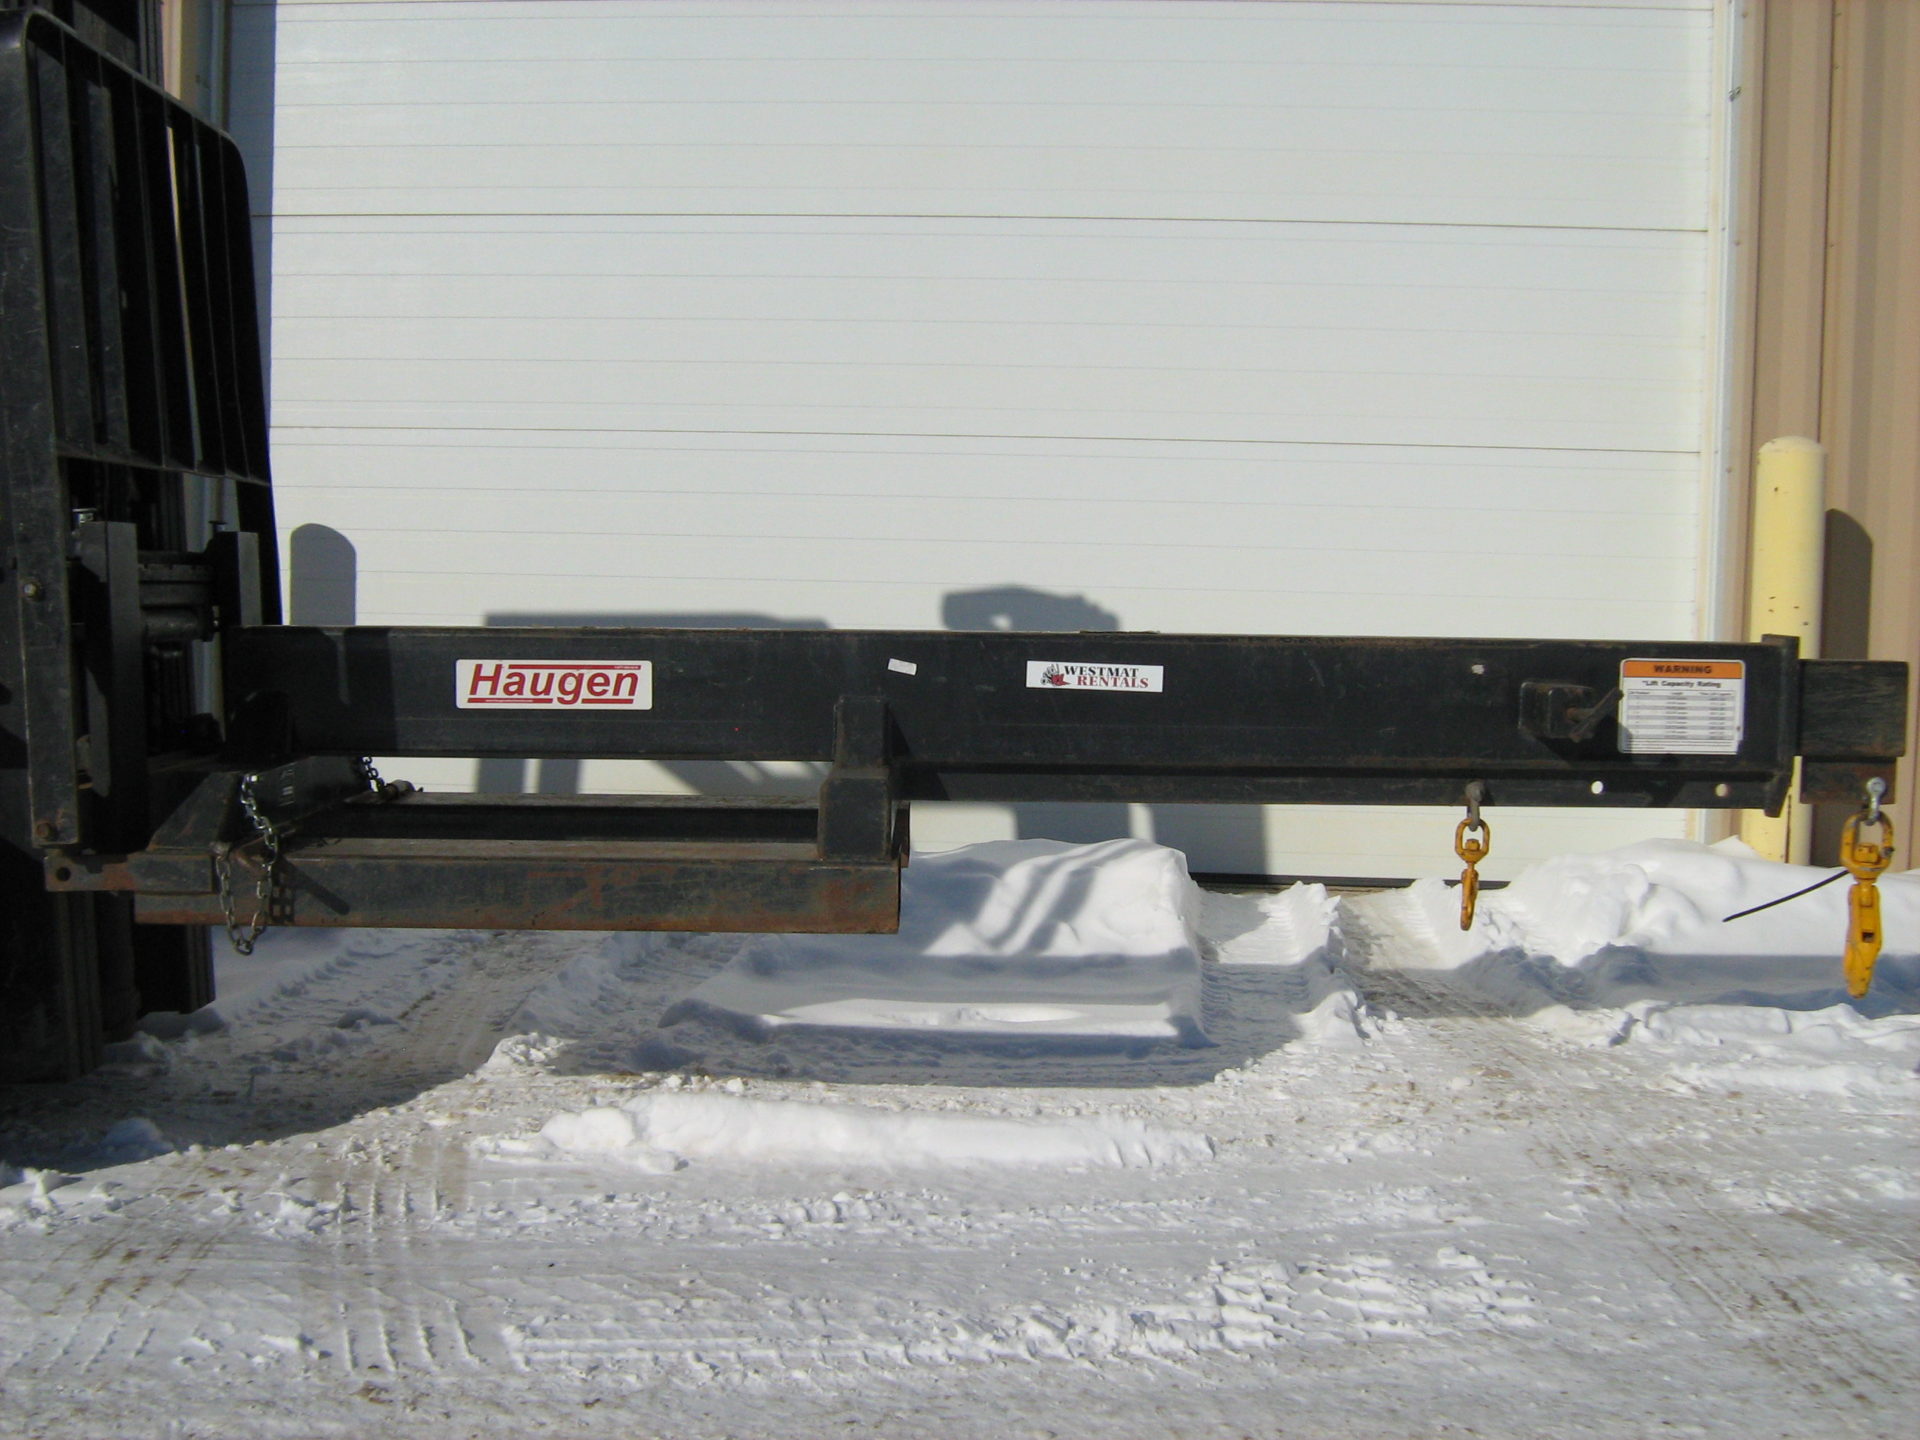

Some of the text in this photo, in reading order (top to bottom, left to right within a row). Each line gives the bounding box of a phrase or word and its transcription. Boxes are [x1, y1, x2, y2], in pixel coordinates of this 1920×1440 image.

[1064, 665, 1139, 678] WESTMAT
[1654, 665, 1712, 674] WARNING
[469, 663, 639, 705] Haugen
[1077, 675, 1149, 688] RENTALS
[1661, 680, 1694, 688] Capacity
